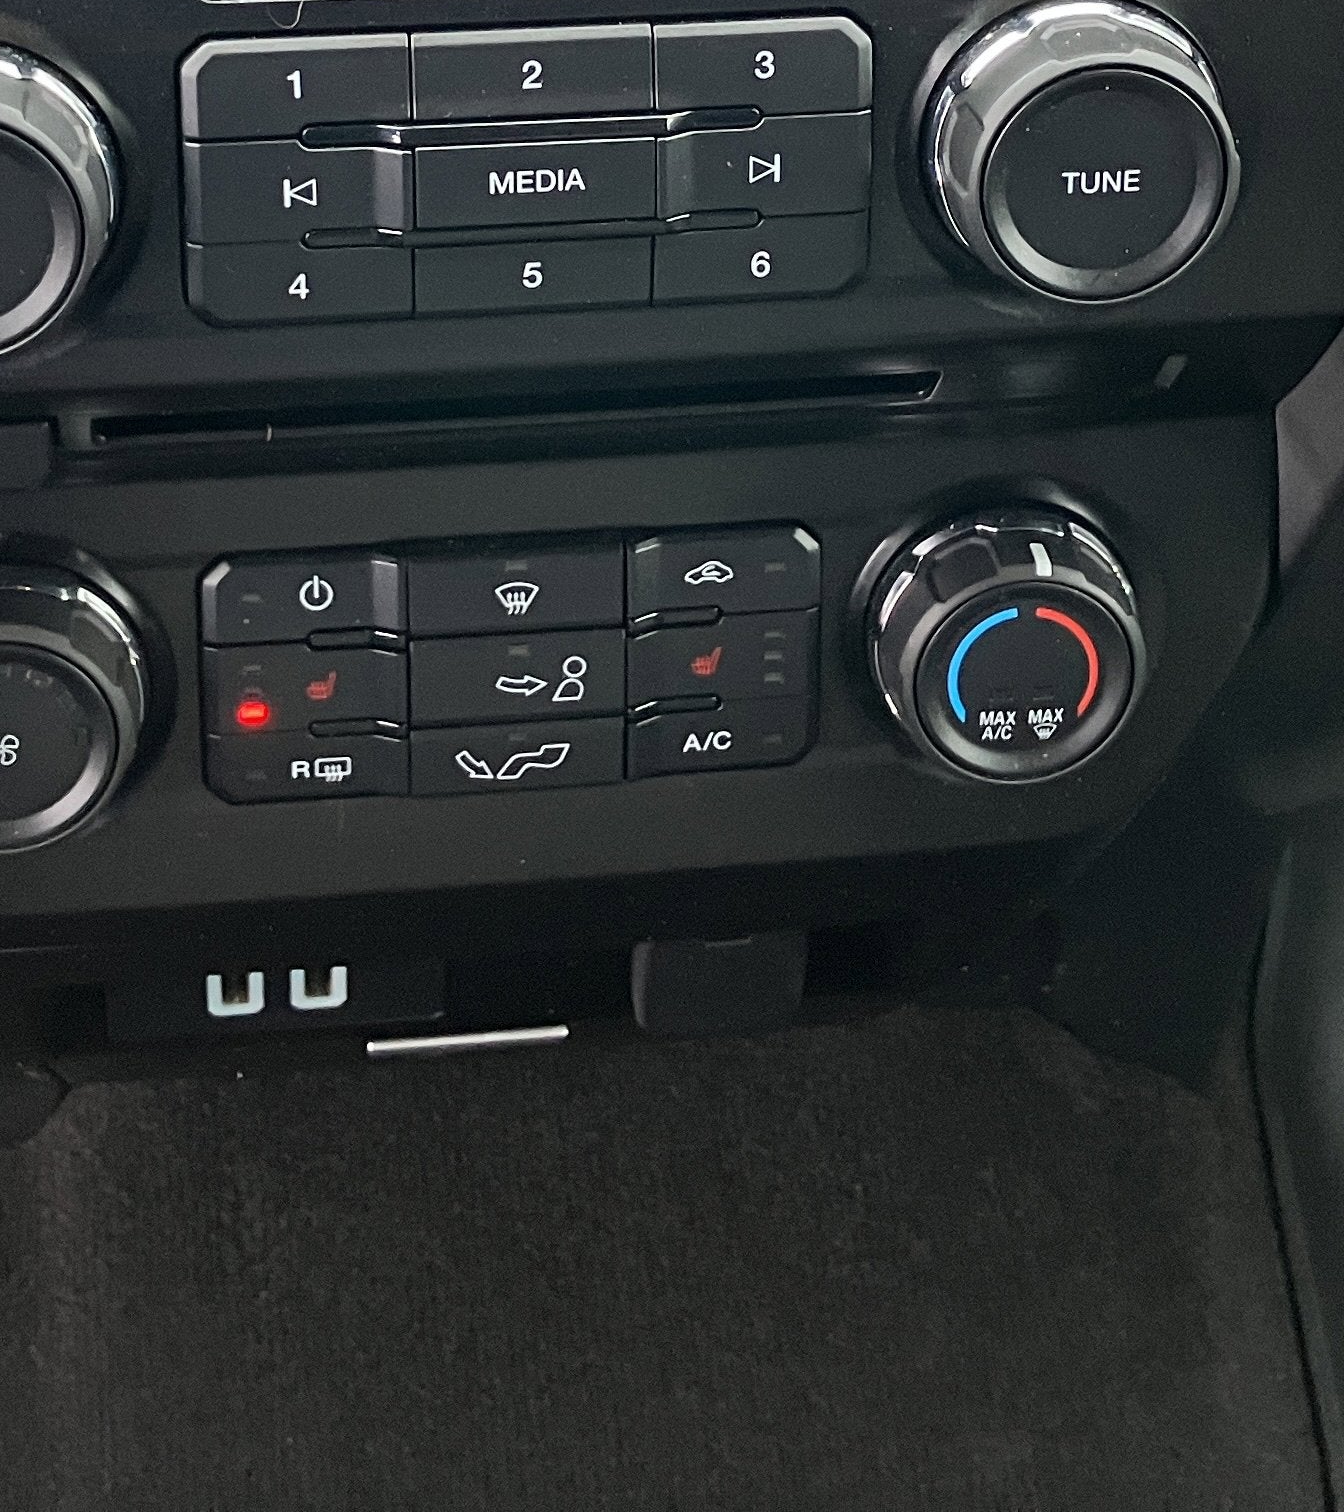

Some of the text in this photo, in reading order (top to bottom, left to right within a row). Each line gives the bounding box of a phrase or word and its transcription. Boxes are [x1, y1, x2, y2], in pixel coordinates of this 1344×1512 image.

[521, 59, 543, 90] 2
[754, 50, 775, 80] 3
[286, 70, 302, 99] 1
[489, 168, 586, 195] MEDIA
[1061, 169, 1141, 195] TUNE
[522, 261, 543, 289] 5
[750, 250, 771, 278] 6
[288, 273, 310, 300] 4
[978, 710, 1017, 727] MAX
[1027, 706, 1065, 725] MAX
[682, 730, 732, 753] A/C
[980, 724, 1014, 741] A/C
